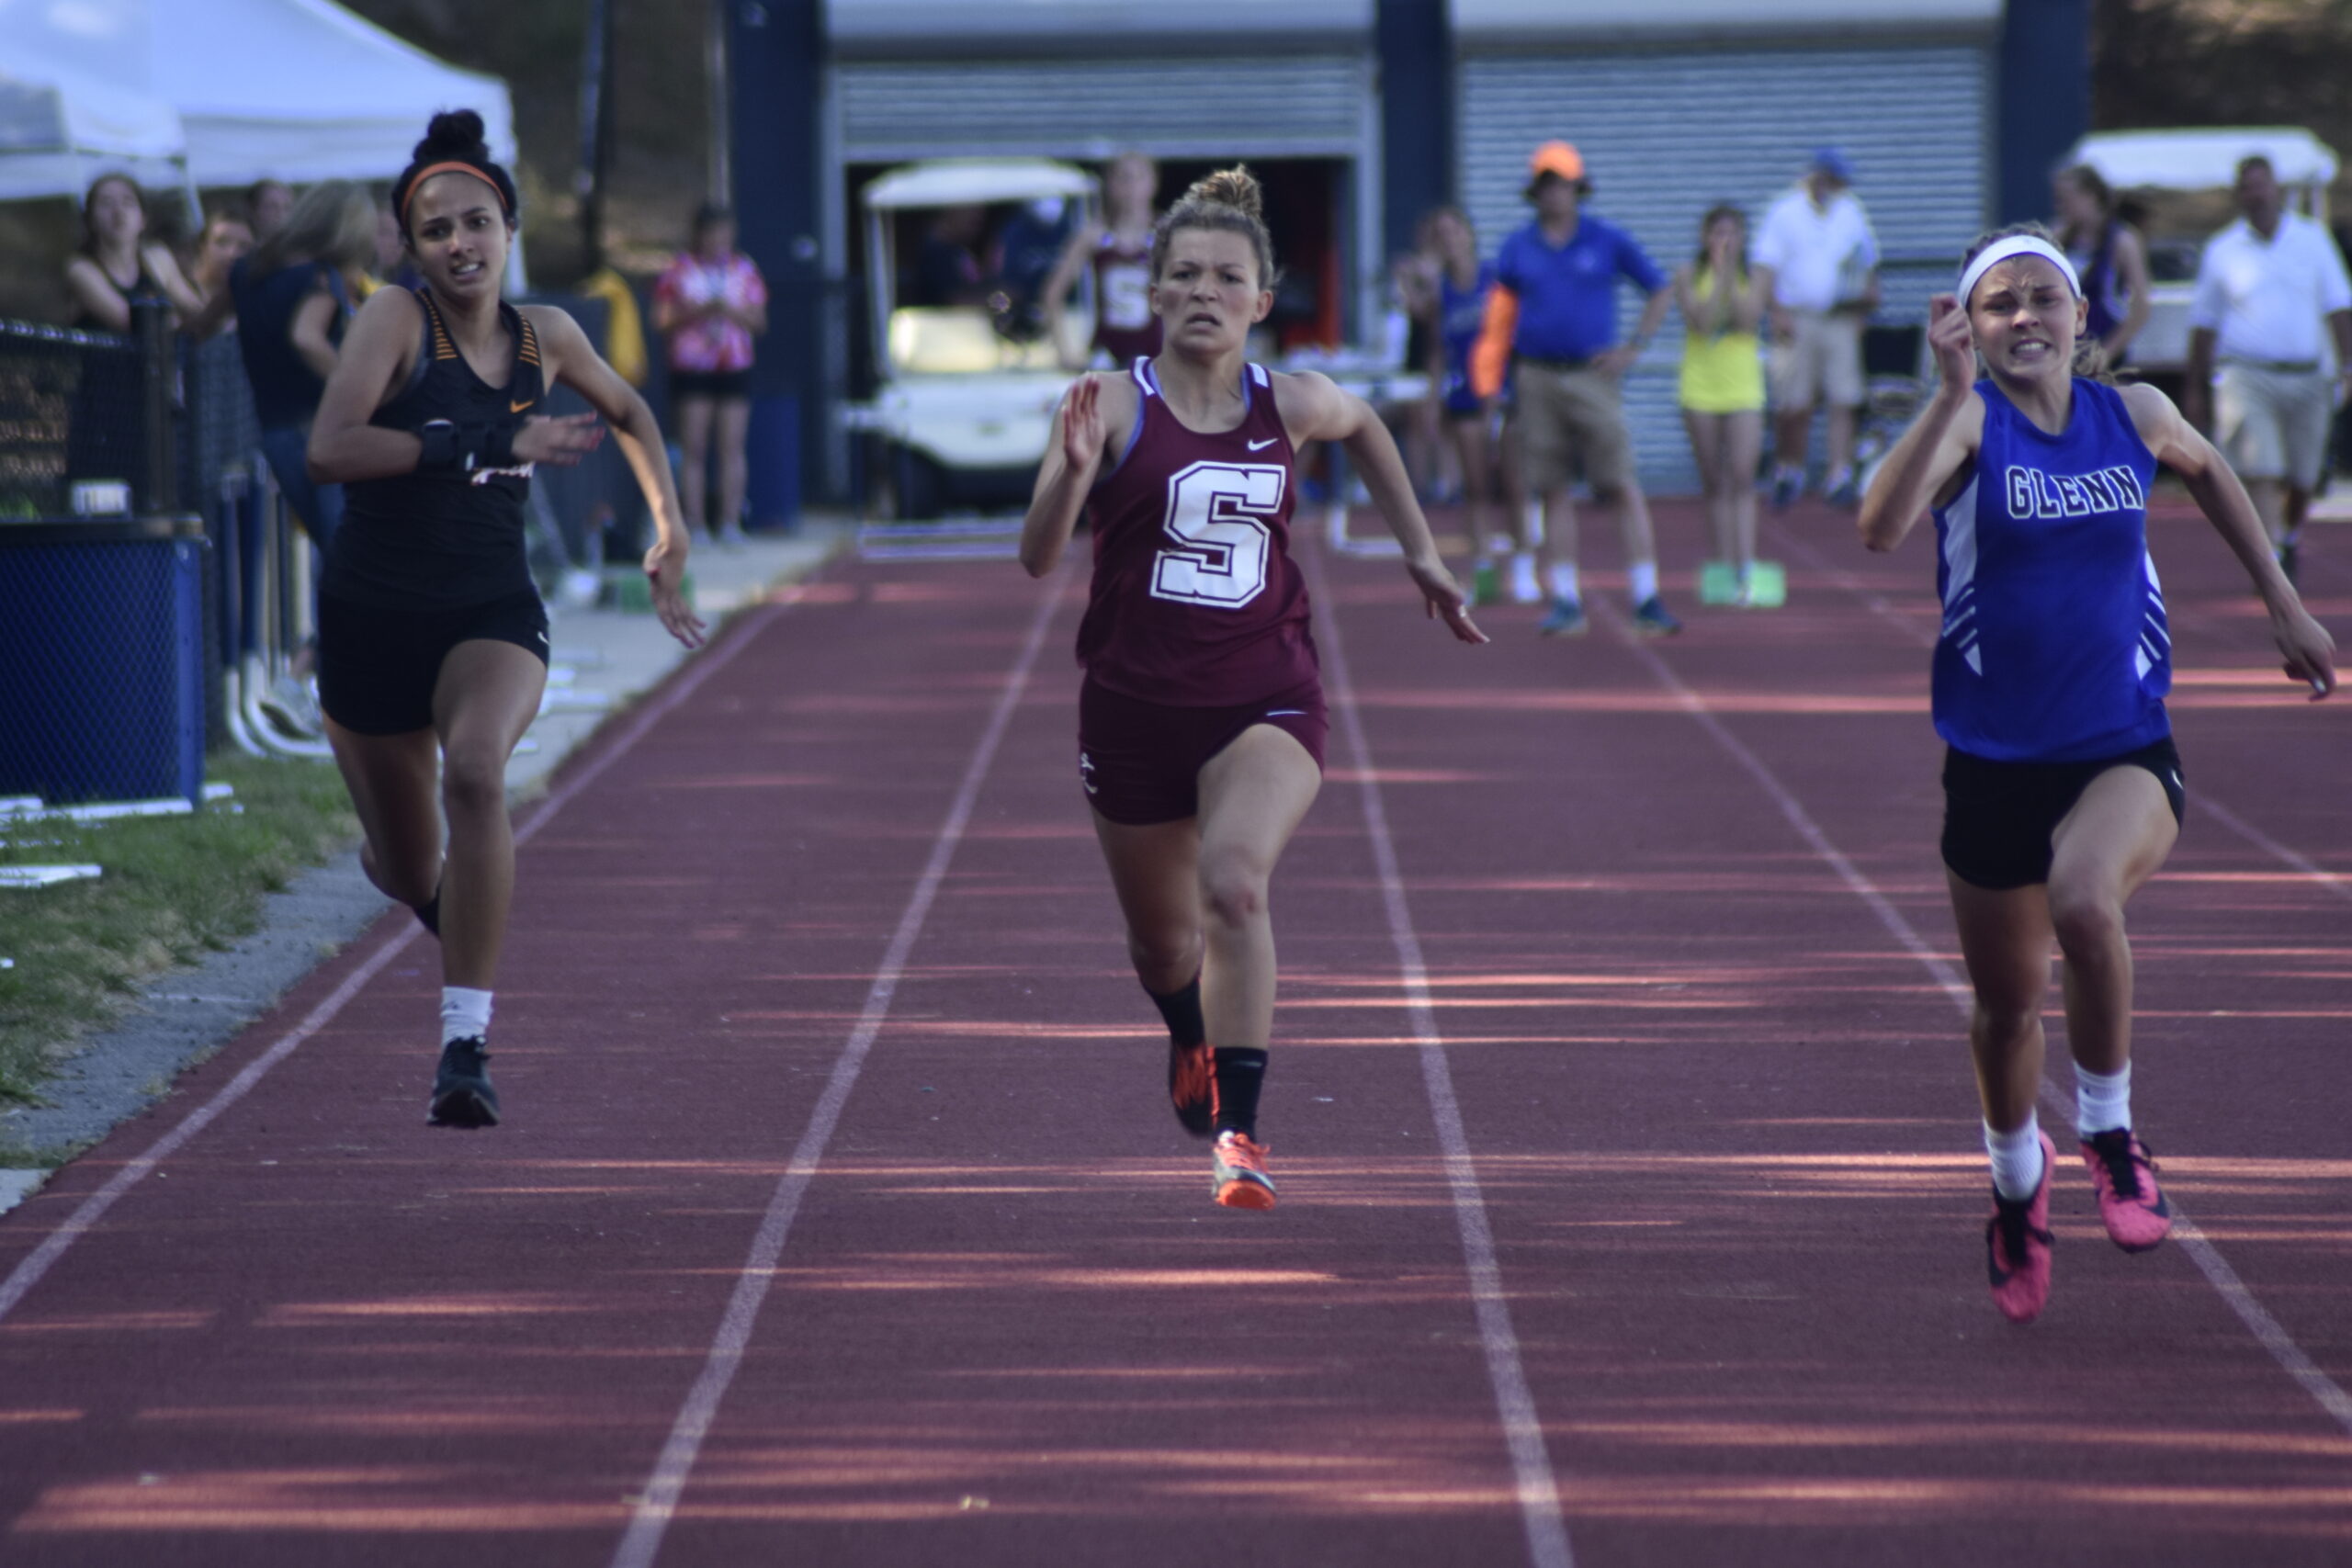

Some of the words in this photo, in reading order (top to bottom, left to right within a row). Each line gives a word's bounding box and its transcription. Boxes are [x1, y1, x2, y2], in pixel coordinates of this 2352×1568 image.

[1103, 265, 1150, 329] S
[2006, 465, 2143, 519] GLENN
[1150, 460, 1285, 608] S
